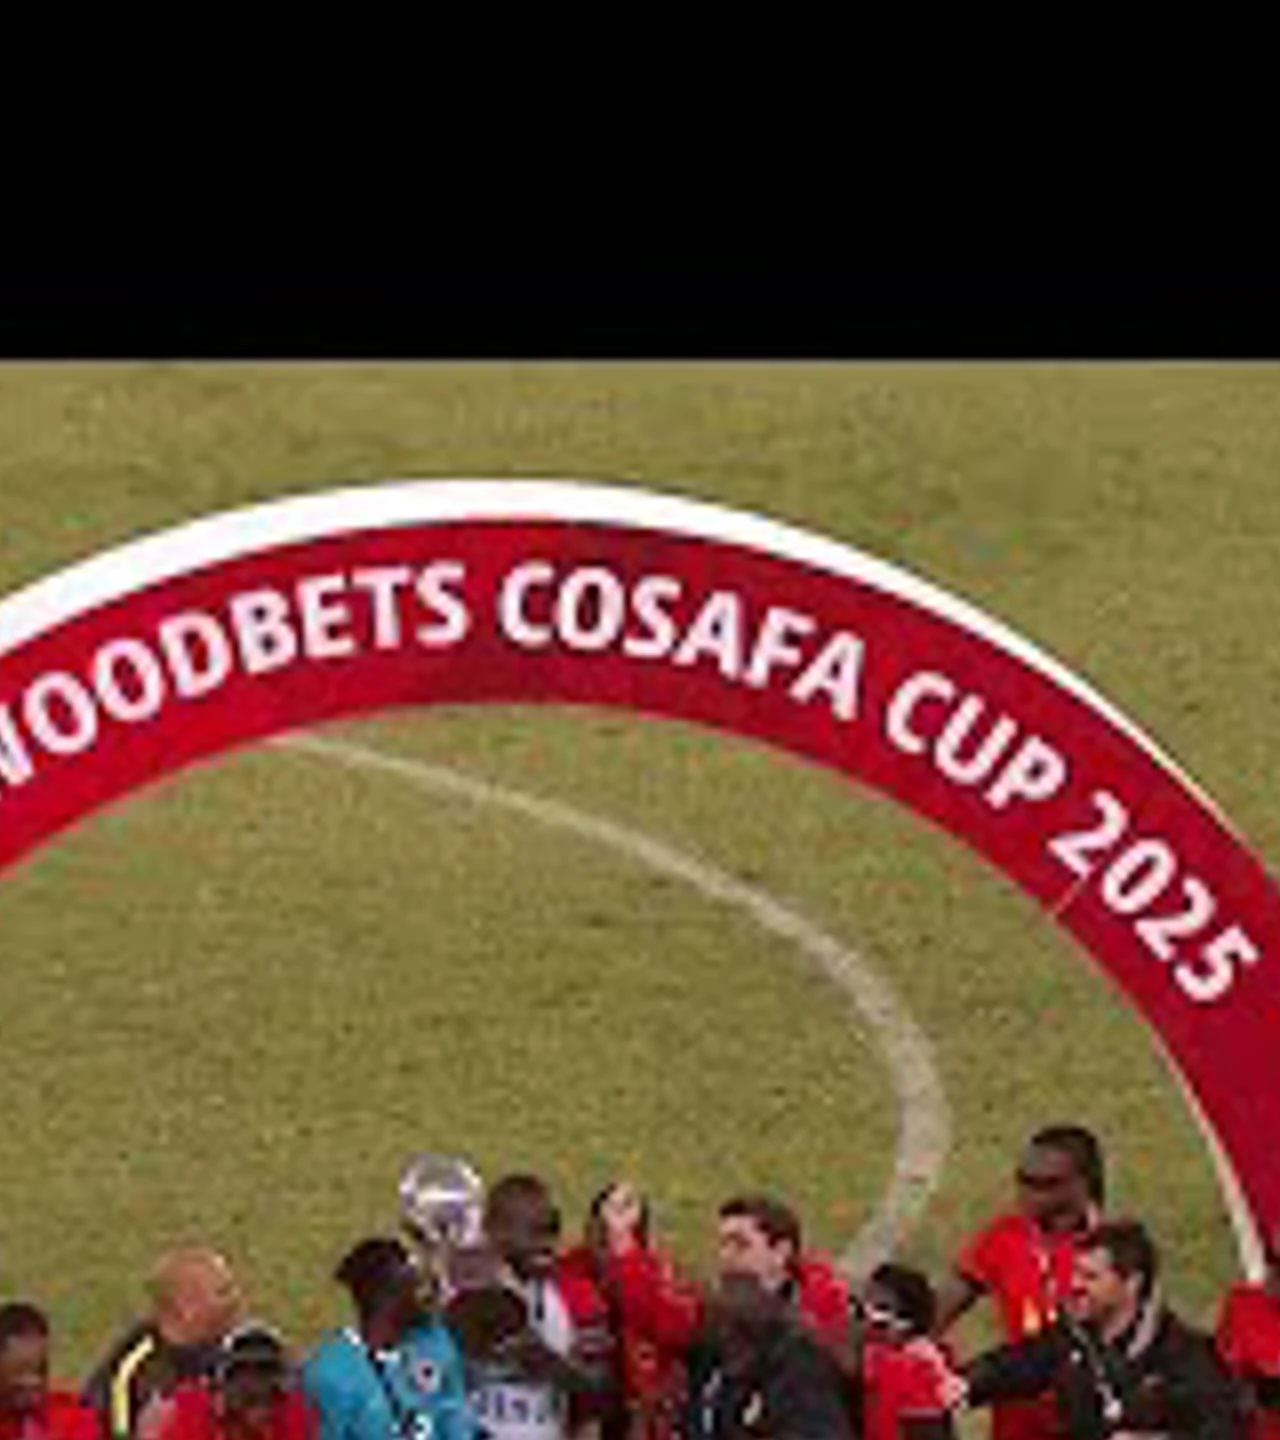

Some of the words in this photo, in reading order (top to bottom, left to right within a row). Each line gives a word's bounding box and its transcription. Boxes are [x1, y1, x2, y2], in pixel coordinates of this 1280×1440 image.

[498, 562, 864, 721] COSAFA
[886, 671, 1065, 808] CUP
[1048, 791, 1259, 1002] 2025
